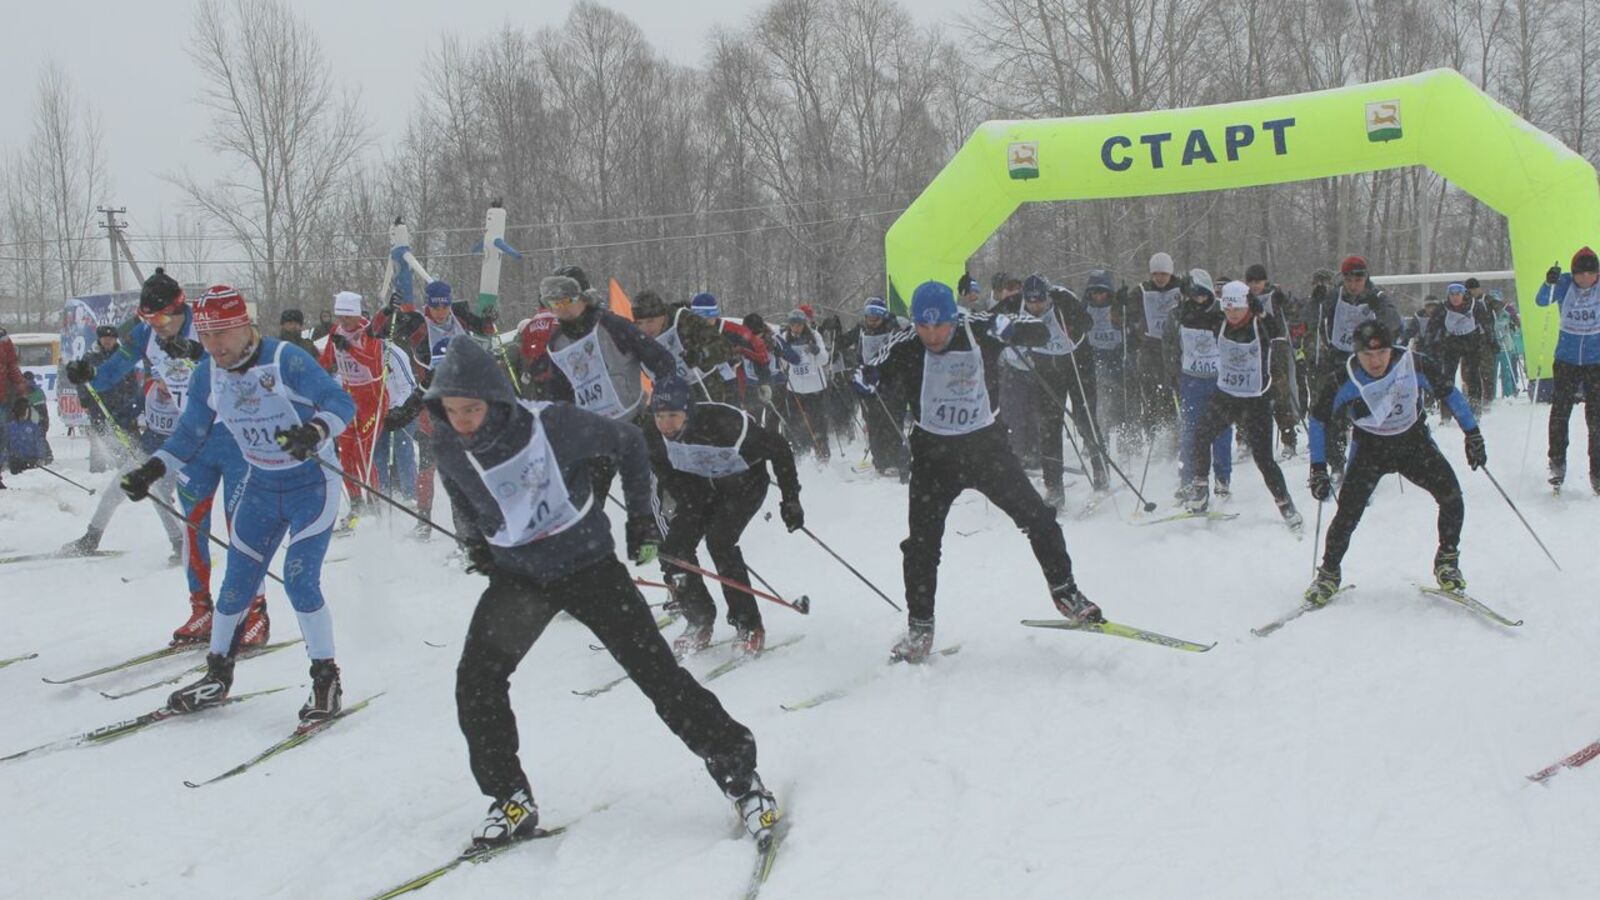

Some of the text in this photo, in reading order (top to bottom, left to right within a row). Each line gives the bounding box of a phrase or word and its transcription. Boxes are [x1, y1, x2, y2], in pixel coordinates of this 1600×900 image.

[1101, 117, 1296, 172] СТАРТ
[193, 311, 211, 321] TAL
[1566, 310, 1596, 320] 4384
[1190, 360, 1217, 376] 4305
[1222, 372, 1251, 386] 4391
[149, 412, 173, 429] 4150
[936, 404, 980, 425] 4105
